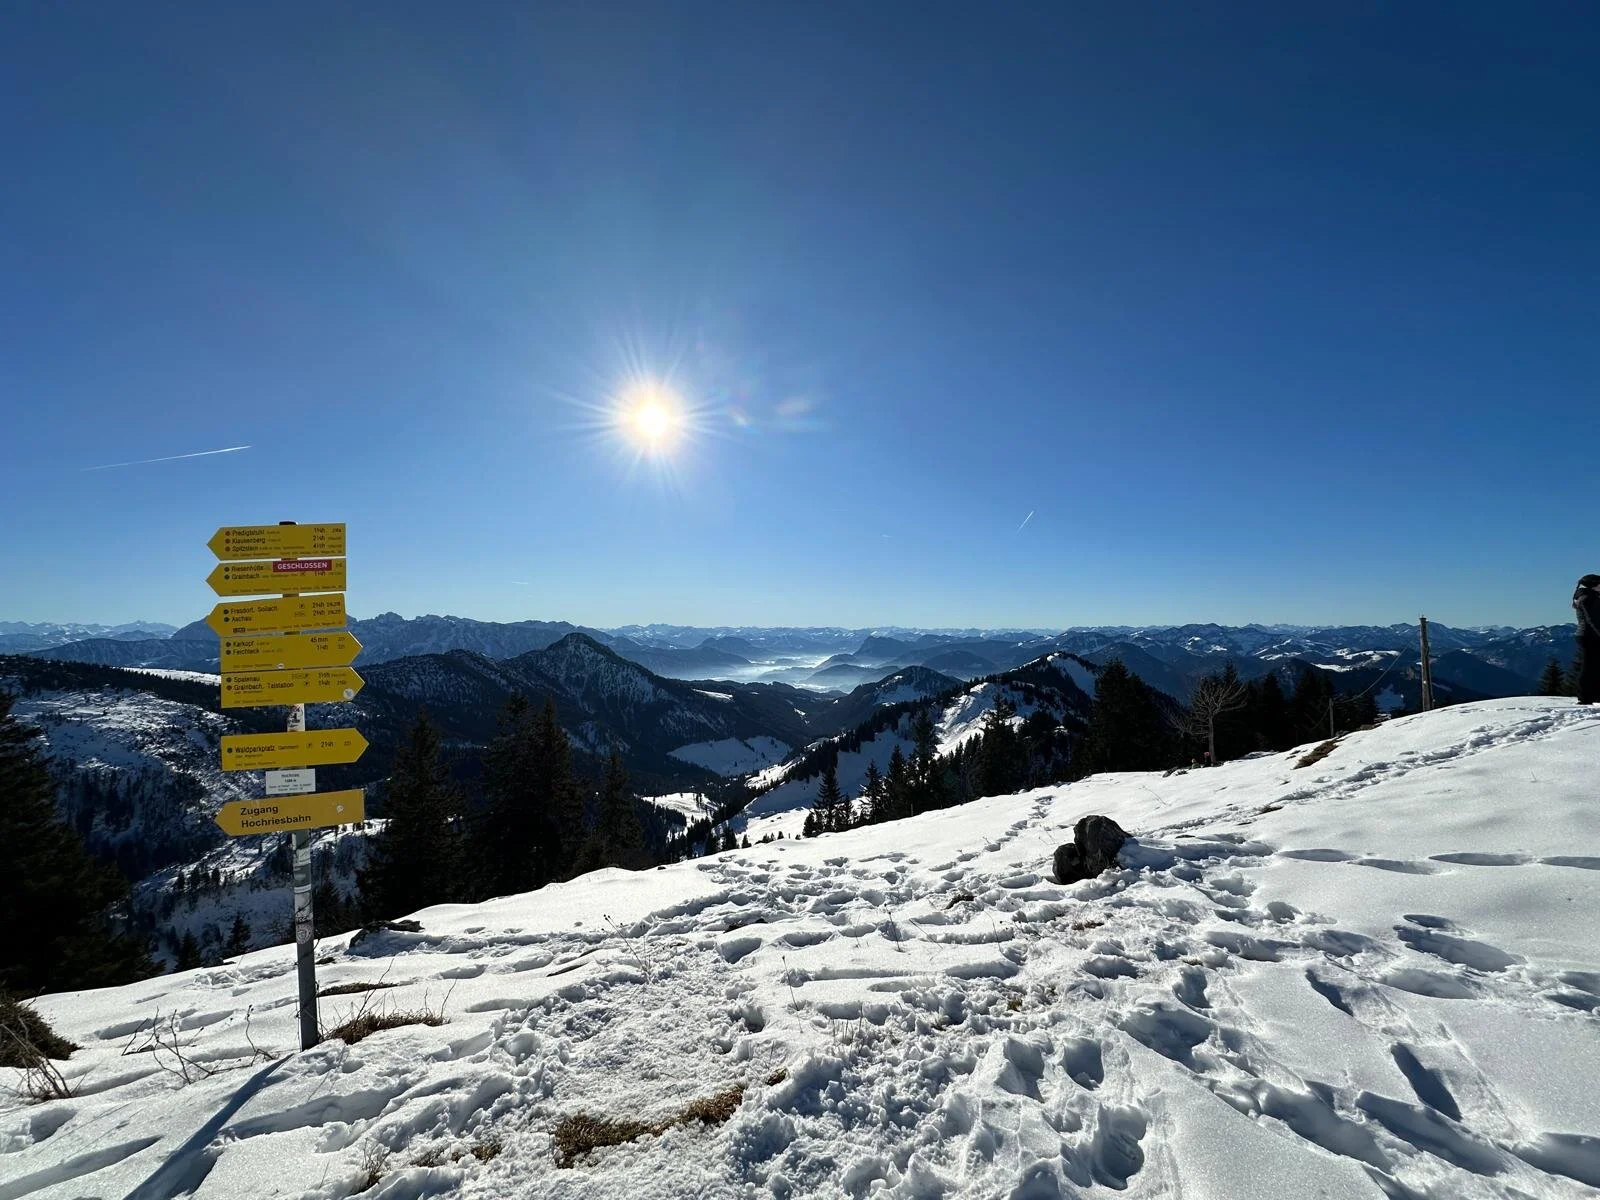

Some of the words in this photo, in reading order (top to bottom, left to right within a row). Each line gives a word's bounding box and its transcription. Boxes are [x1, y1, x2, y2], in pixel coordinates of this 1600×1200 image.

[277, 562, 328, 570] GESCHLOSSEN
[240, 805, 279, 816] Zugang
[241, 815, 311, 828] Hochriesbahn
